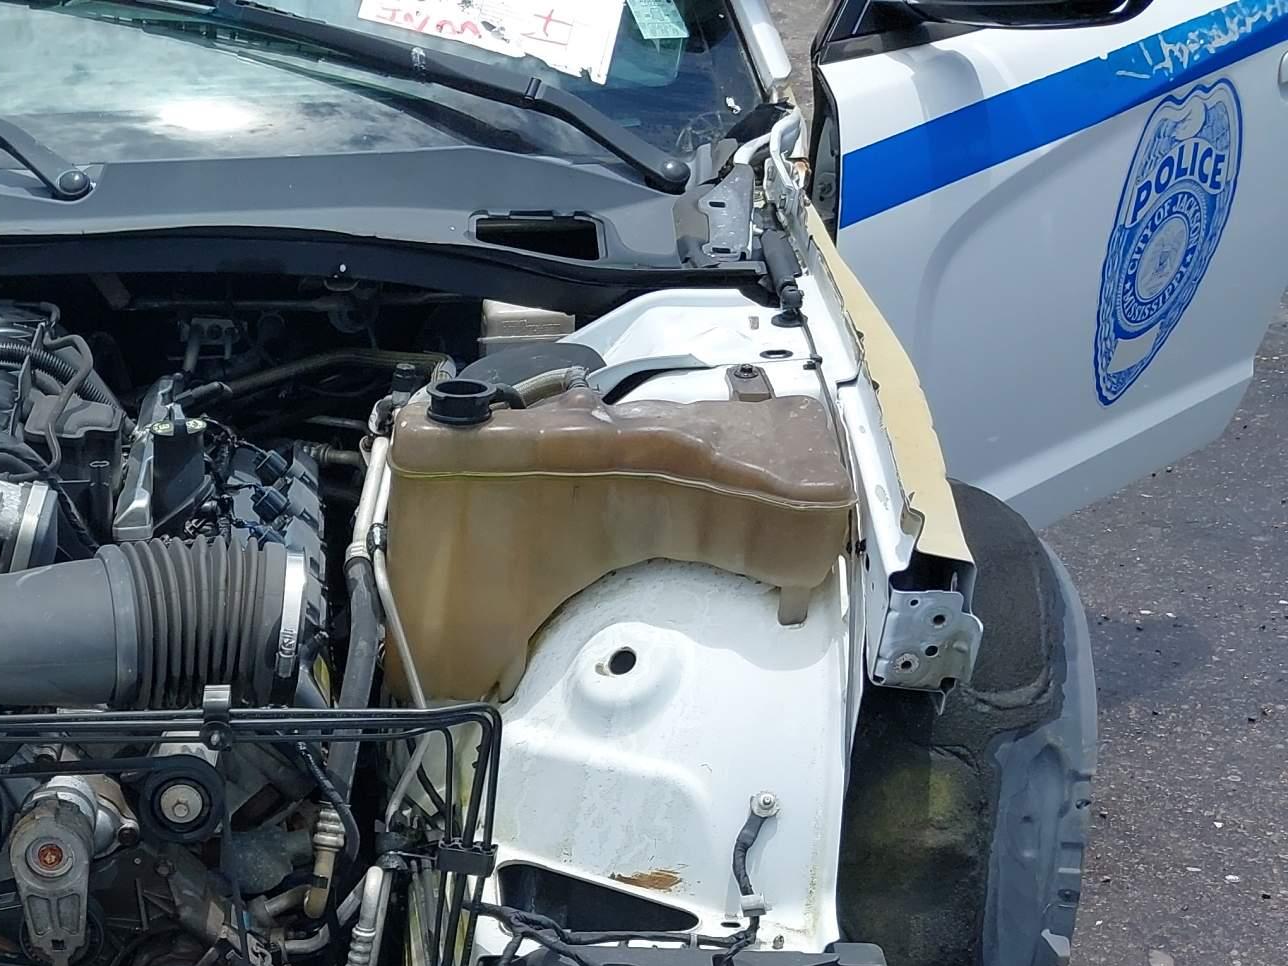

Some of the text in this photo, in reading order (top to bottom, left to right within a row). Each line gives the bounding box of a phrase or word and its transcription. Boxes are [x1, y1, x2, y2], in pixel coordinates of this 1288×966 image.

[1131, 142, 1226, 225] POLICE
[1128, 193, 1201, 275] CITY OF JACKSON
[1123, 265, 1187, 321] MISSISSIPPI
